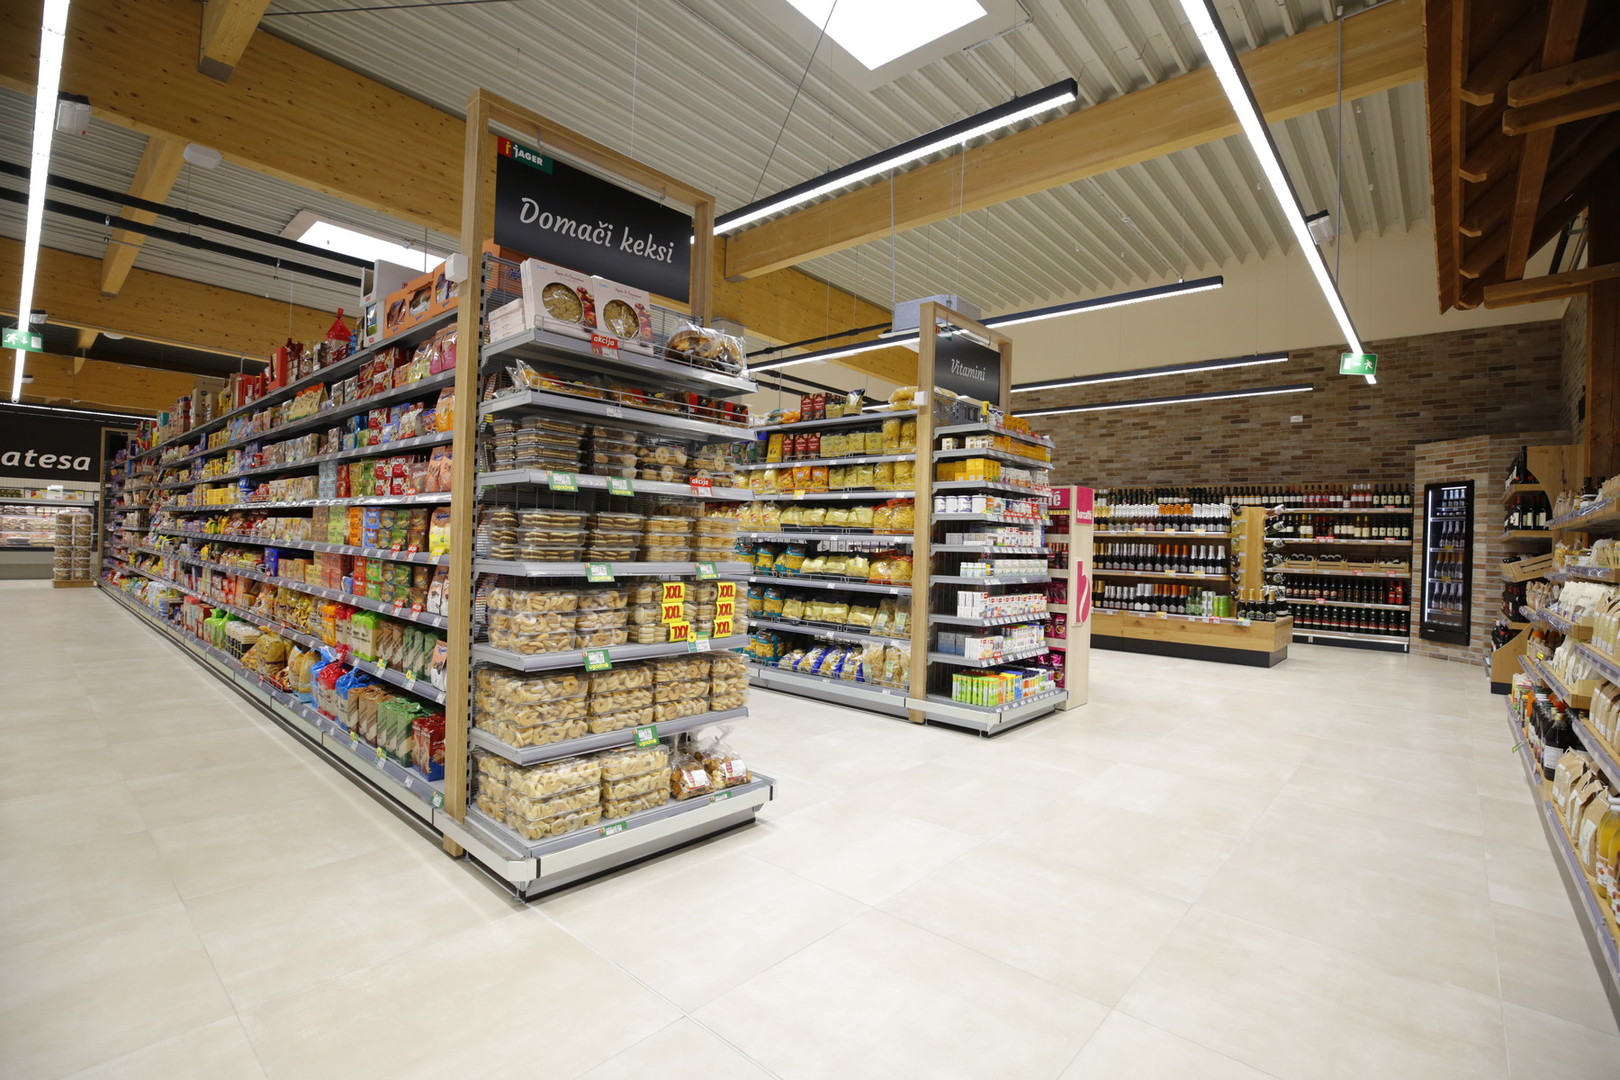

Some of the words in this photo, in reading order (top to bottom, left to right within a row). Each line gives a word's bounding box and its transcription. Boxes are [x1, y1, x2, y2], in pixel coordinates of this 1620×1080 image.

[519, 197, 614, 247] Domači
[620, 226, 674, 264] keksi
[593, 336, 615, 347] akcija
[951, 358, 986, 381] Vitamini
[1, 449, 91, 471] atesa
[664, 585, 683, 599] XXL
[719, 584, 735, 598] XXL
[663, 605, 682, 619] XXL
[718, 603, 733, 617] XXL
[715, 621, 731, 635] XXL
